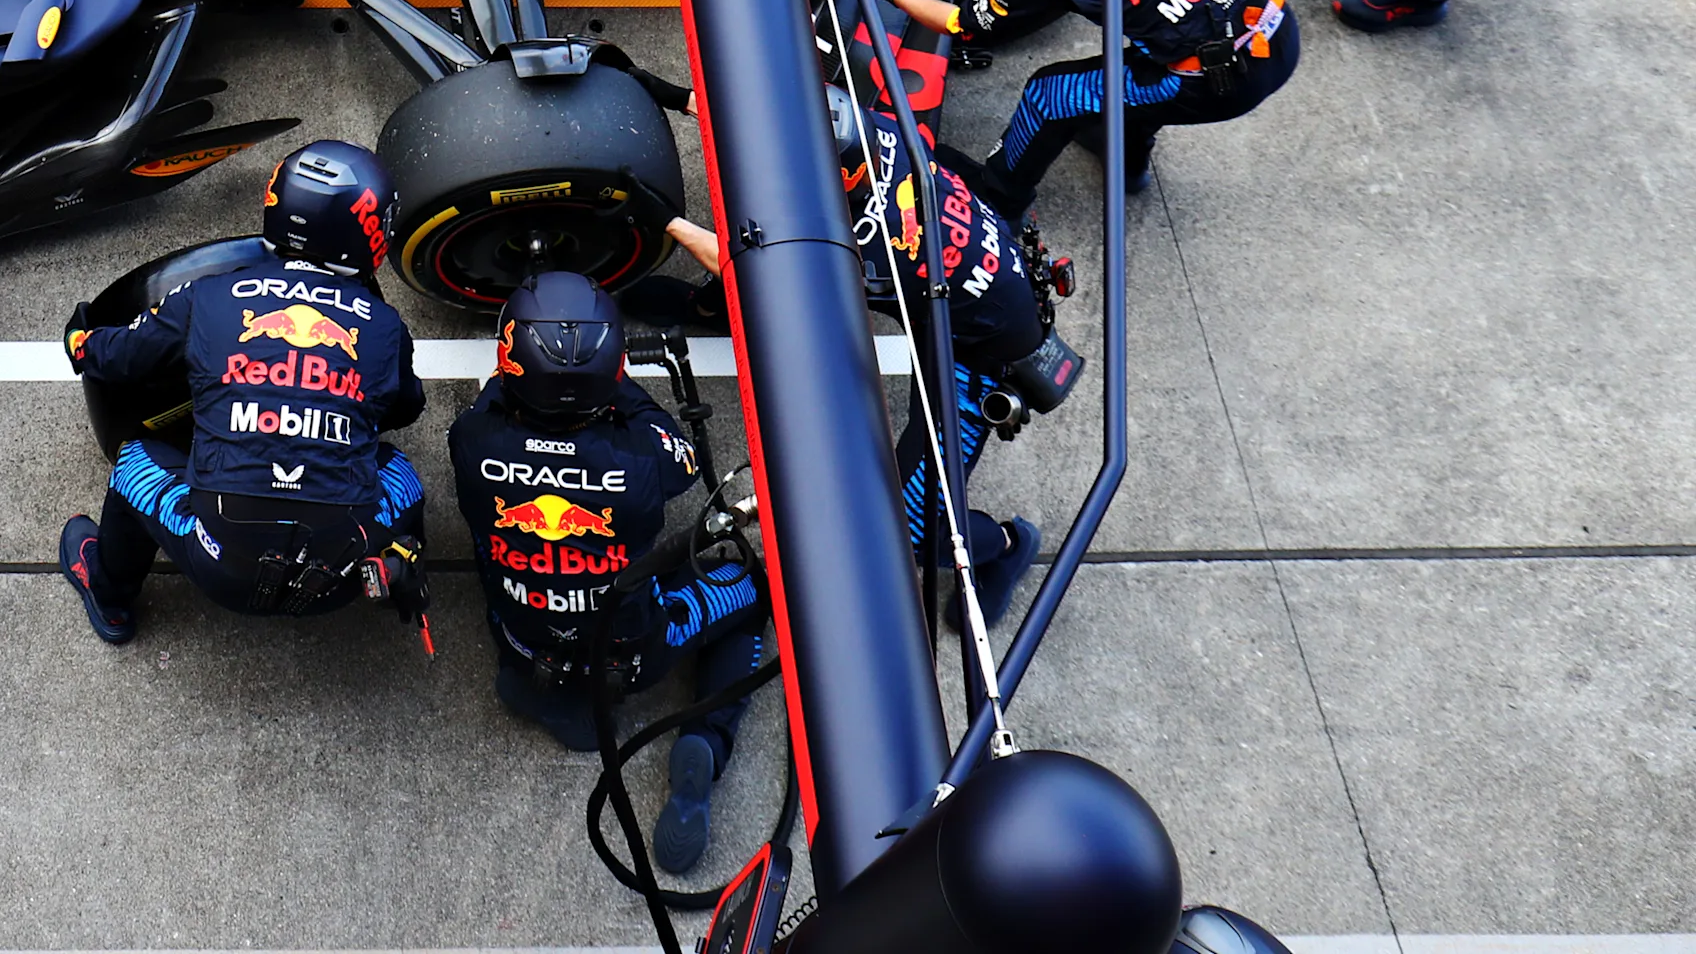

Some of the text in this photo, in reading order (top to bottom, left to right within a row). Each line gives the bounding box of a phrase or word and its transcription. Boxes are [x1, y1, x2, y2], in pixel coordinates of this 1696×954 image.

[163, 145, 245, 167] RAUCH
[491, 181, 572, 206] PIRELLI
[852, 128, 898, 246] ORACLE
[962, 218, 1001, 299] Mobil
[231, 278, 372, 321] ORACLE
[221, 350, 297, 388] Red
[229, 401, 322, 440] Mobil
[525, 437, 576, 455] sparco
[480, 459, 627, 492] ORACLE
[488, 534, 631, 576] Red Bull
[503, 576, 586, 613] Mobil
